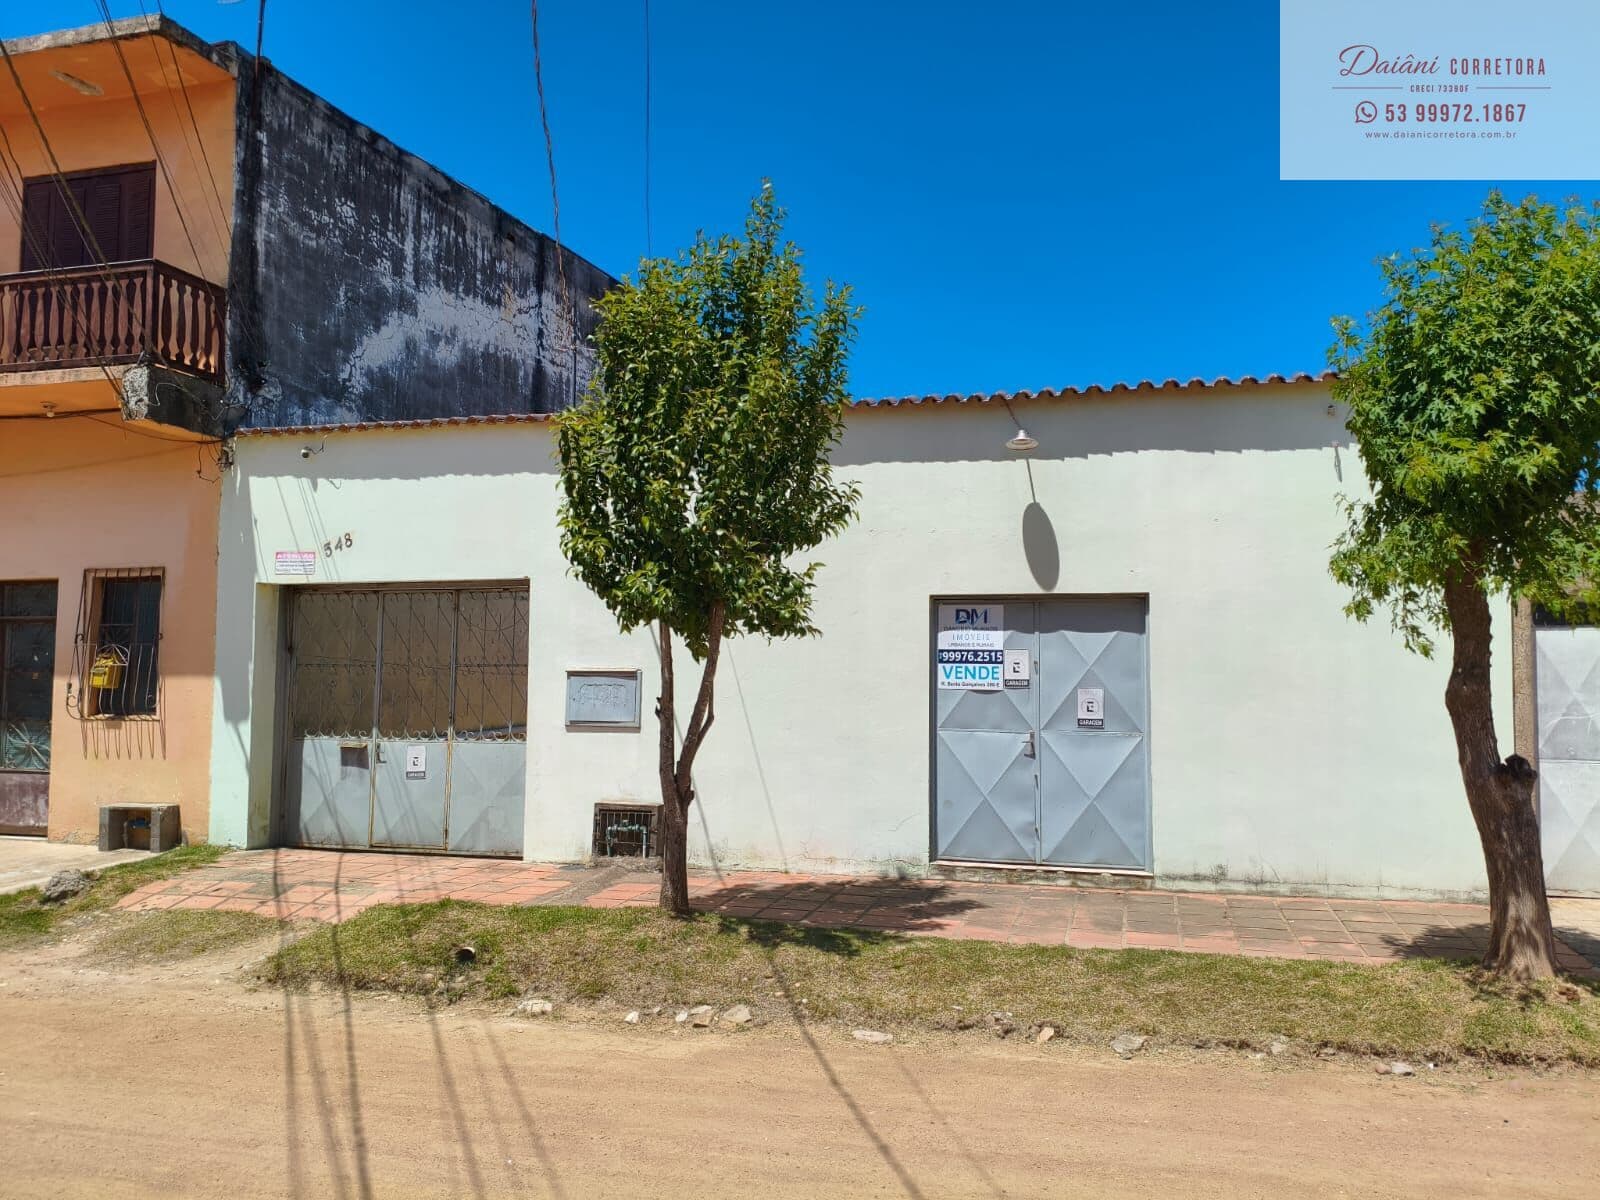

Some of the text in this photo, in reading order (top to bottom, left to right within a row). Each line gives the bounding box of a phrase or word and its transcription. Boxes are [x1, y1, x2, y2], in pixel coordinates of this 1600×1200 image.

[323, 532, 353, 558] 548
[955, 608, 988, 624] DM
[942, 651, 1003, 662] 99976.2515
[942, 665, 1000, 680] VENDE
